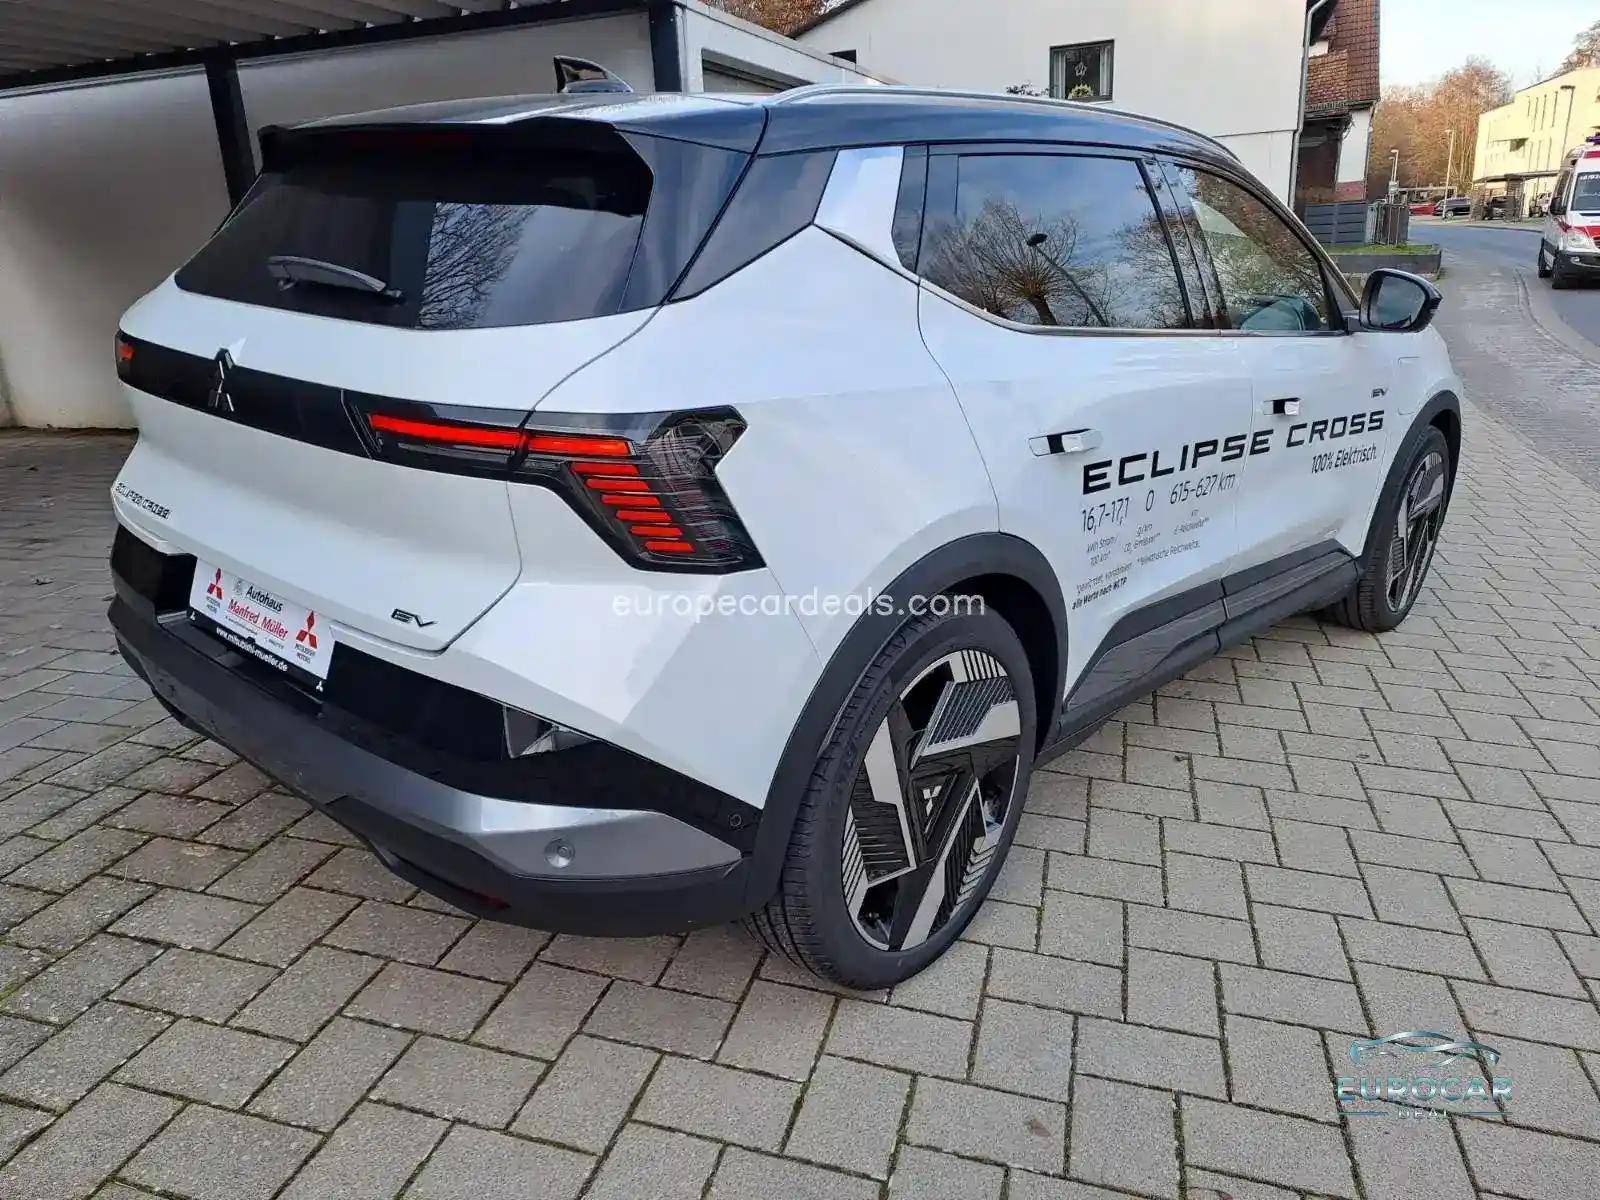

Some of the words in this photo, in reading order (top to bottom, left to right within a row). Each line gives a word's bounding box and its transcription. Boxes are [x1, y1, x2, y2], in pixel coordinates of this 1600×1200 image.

[1370, 388, 1388, 399] EV
[1083, 429, 1274, 494] ECLIPSE
[1286, 410, 1385, 447] CROSS
[1311, 451, 1334, 474] 100%
[142, 498, 170, 520] CROSS
[1081, 497, 1129, 534] 16,7-17,1
[1145, 489, 1155, 512] 0
[1169, 474, 1218, 504] 615-627
[1218, 471, 1236, 492] km
[246, 586, 284, 612] Autohaus
[228, 599, 260, 624] Manfred
[261, 616, 289, 639] Müller
[391, 608, 438, 628] EV
